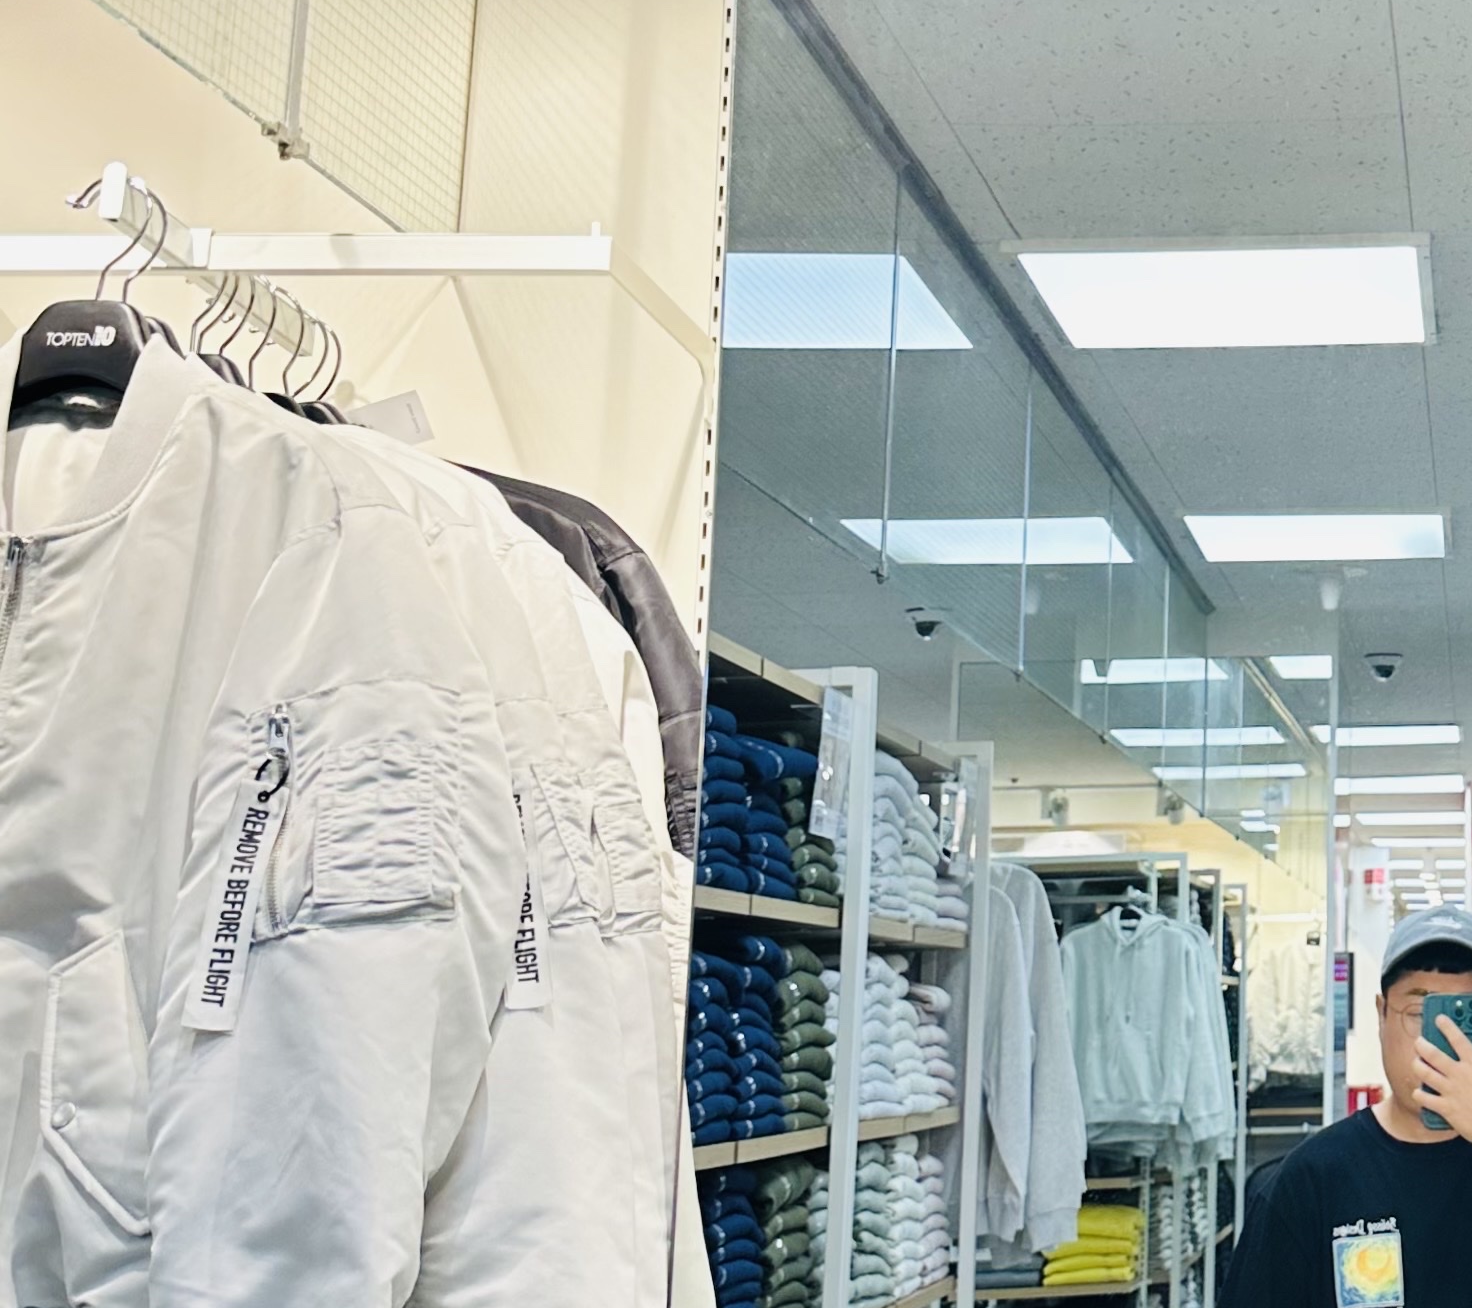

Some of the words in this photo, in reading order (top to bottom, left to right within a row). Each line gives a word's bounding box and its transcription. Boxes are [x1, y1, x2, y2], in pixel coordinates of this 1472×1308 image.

[230, 806, 269, 874] REMOVE
[214, 879, 250, 943] BEFORE
[201, 948, 235, 1007] FLIGHT
[514, 928, 540, 983] FLIGHT
